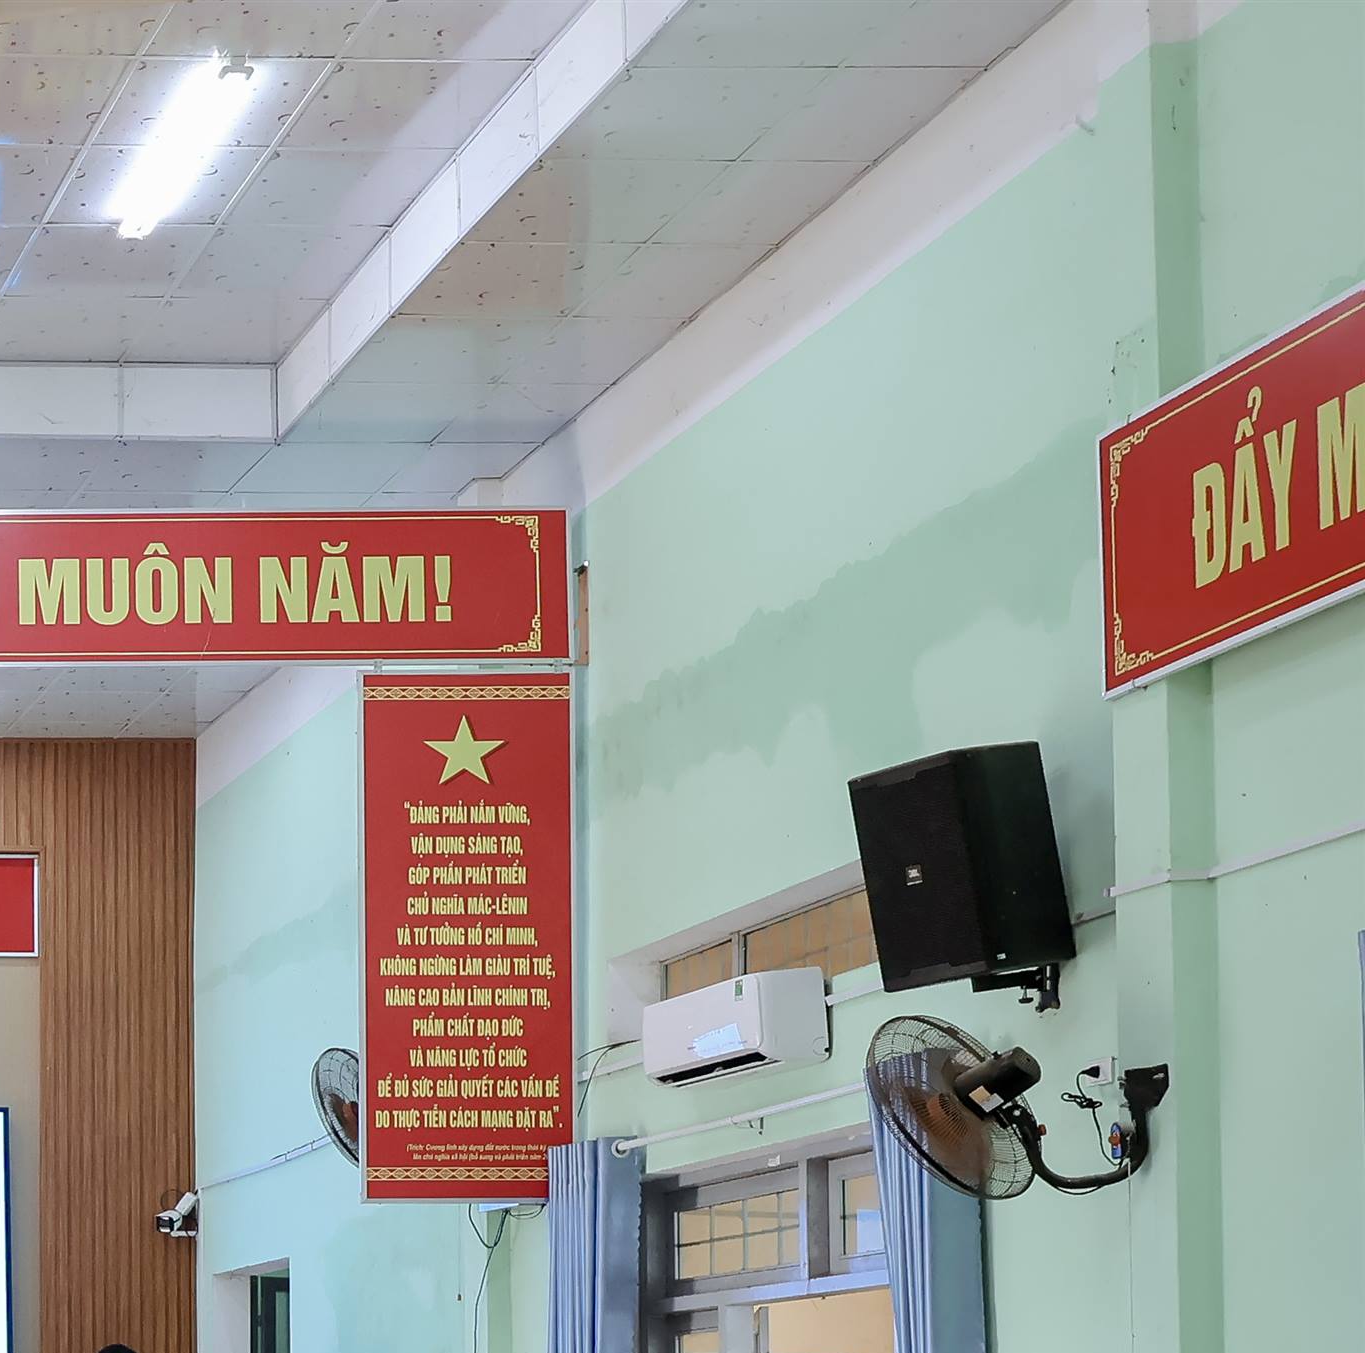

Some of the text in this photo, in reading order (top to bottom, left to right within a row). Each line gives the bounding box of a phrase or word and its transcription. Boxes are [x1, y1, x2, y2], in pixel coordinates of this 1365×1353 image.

[1192, 386, 1297, 589] ĐẨY
[19, 543, 232, 625] MUÔN
[260, 542, 451, 623] NĂM!
[442, 799, 468, 824] PHẢI
[410, 832, 524, 859] VẬN DỤNG SÁNG TẠO,
[408, 863, 431, 885] GÓP
[465, 863, 494, 885] PHÁT
[407, 890, 528, 916] CHỦ NGHĨA MÁC-LÊNIN
[396, 923, 412, 946] VÀ
[413, 925, 429, 946] TƯ
[484, 923, 504, 946] CHÍ
[505, 927, 538, 947] MINH,
[379, 954, 417, 976] KHÔNG
[459, 954, 483, 976] LÀM
[485, 953, 511, 976] GIÀU
[512, 953, 530, 976] TRÍ
[532, 953, 556, 980] TUỆ,
[385, 984, 416, 1007] NÂNG
[418, 988, 440, 1007] CAO
[442, 982, 465, 1007] BẢN
[494, 984, 528, 1007] CHÍNH
[530, 988, 551, 1010] TRỊ,
[476, 1015, 524, 1041] ĐẠO ĐỨC
[409, 1045, 424, 1068] VÀ
[426, 1045, 457, 1067] NĂNG
[459, 1047, 480, 1071] LỰC
[394, 1073, 410, 1098] ĐỦ
[436, 1073, 458, 1098] GIẢI
[496, 1076, 519, 1098] CÁC
[375, 1109, 390, 1129] DO
[392, 1108, 421, 1132] THỰC
[449, 1106, 479, 1128] CÁCH
[480, 1109, 514, 1132] MẠNG
